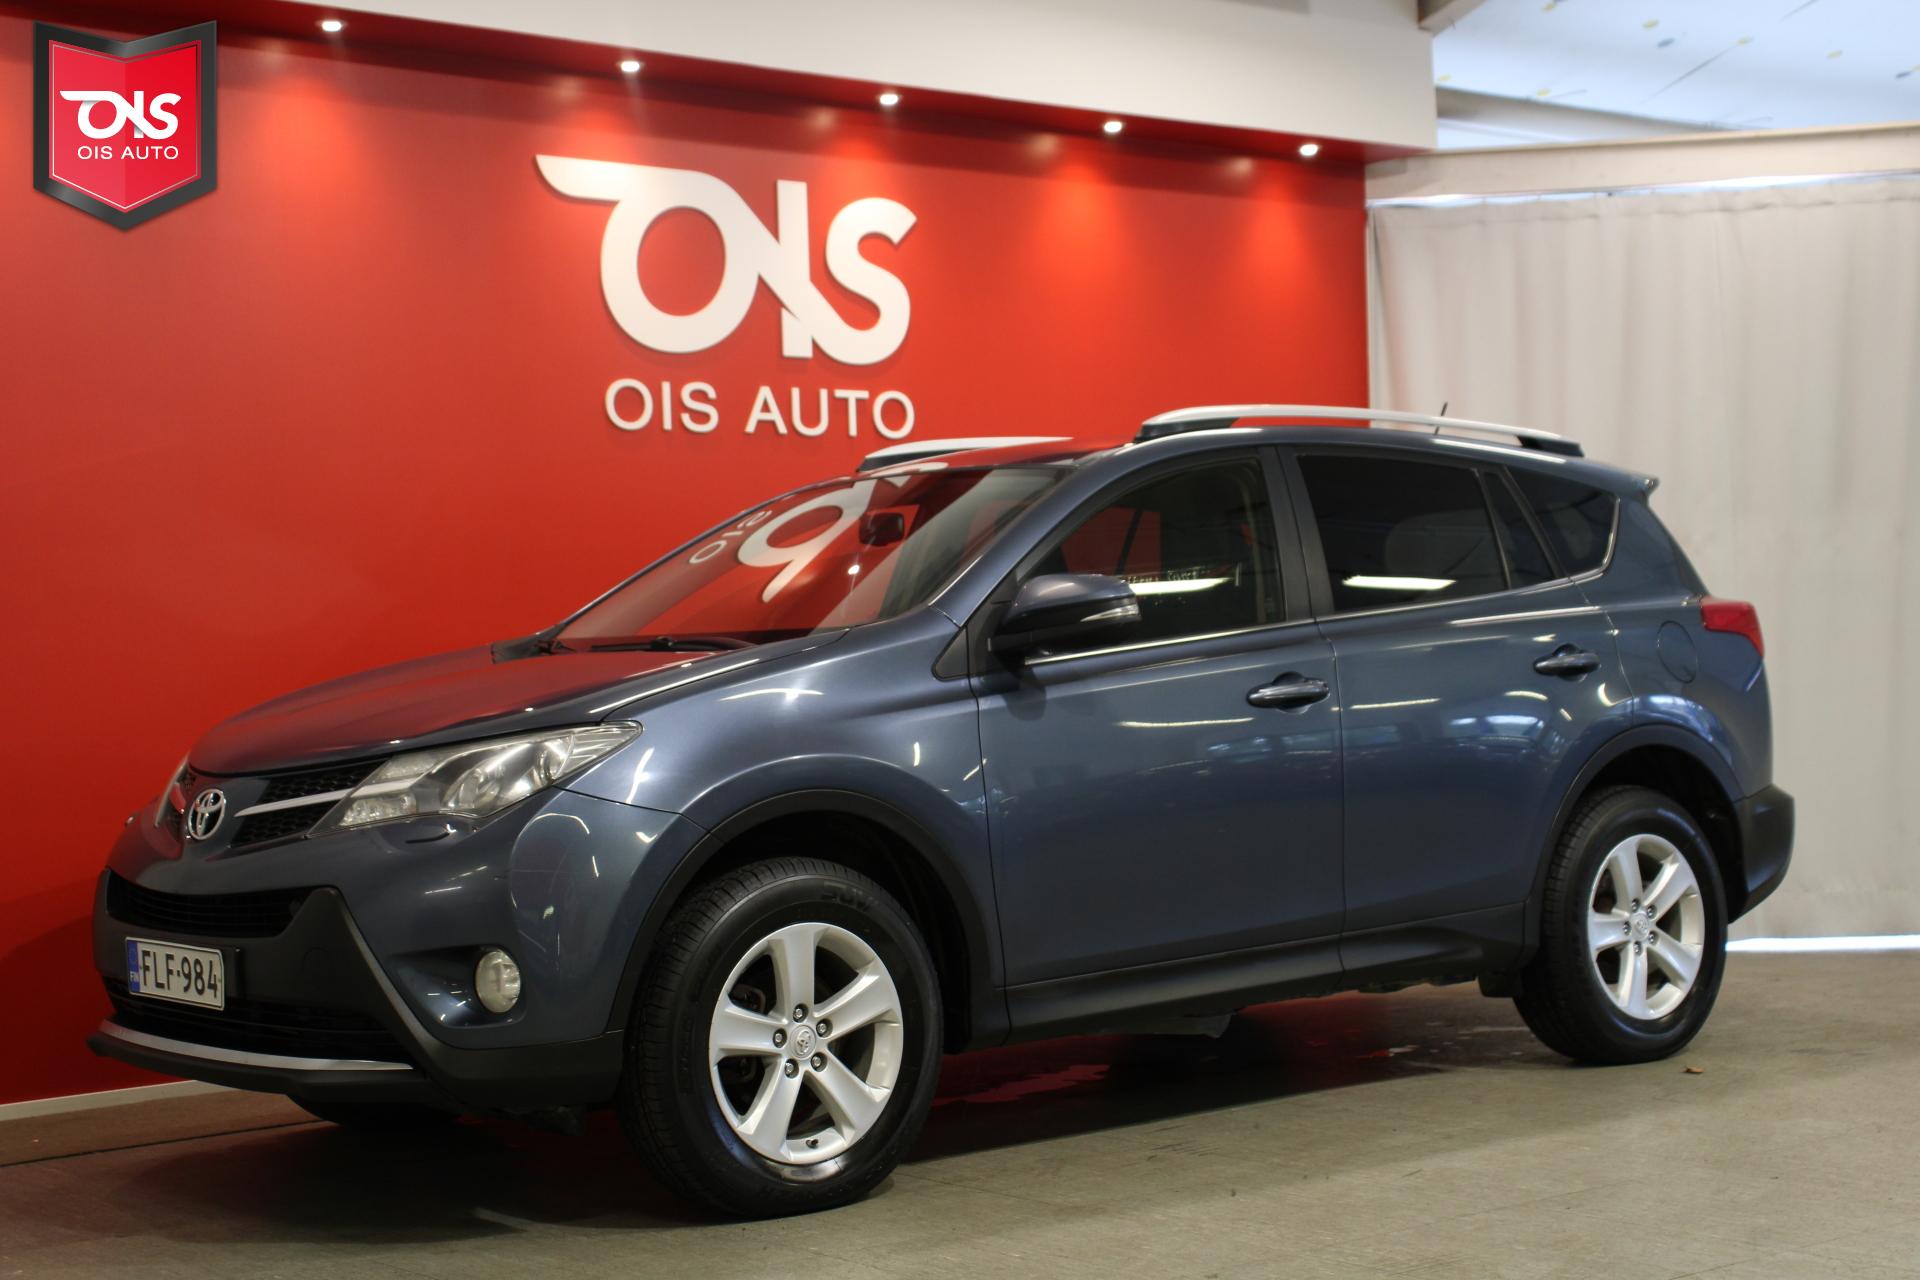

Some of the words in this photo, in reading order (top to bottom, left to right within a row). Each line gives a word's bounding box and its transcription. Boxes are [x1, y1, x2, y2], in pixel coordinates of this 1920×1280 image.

[535, 154, 917, 366] OIS
[605, 378, 719, 433] OIS
[744, 386, 915, 439] AUTO
[141, 950, 218, 998] FLF-984
